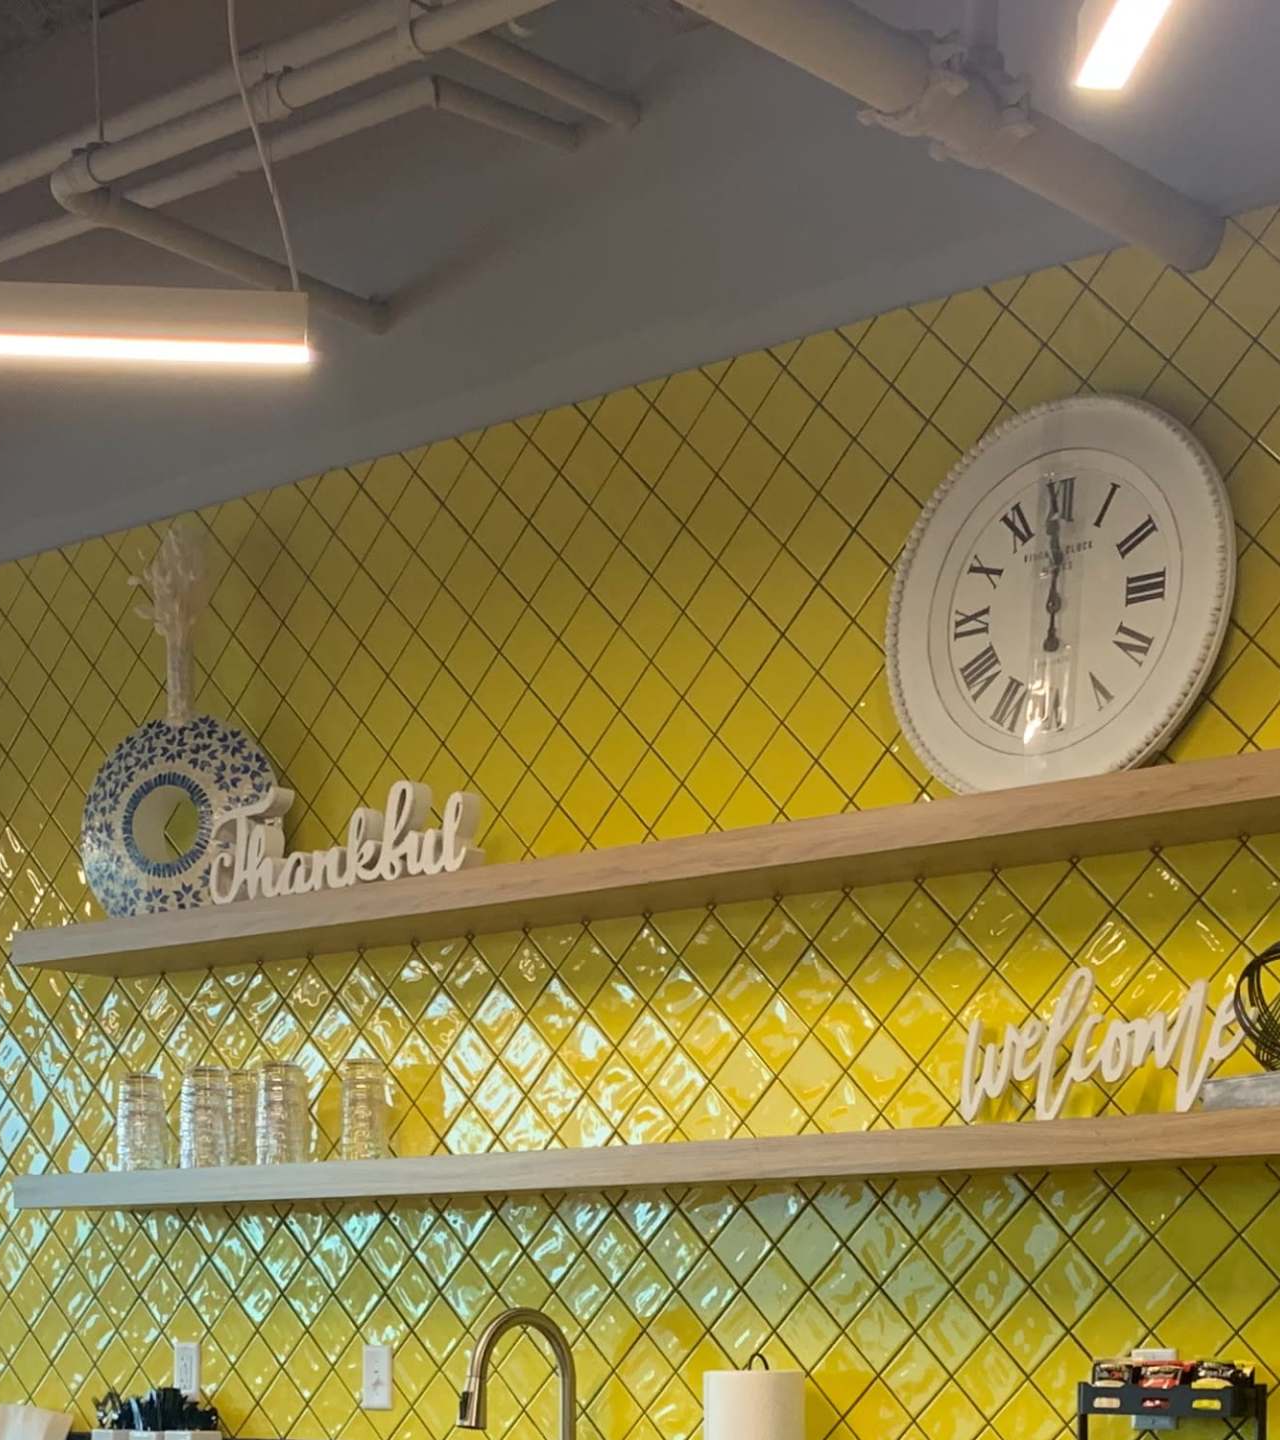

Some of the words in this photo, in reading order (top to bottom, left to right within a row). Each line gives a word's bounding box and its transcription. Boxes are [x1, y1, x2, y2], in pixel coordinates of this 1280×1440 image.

[1000, 502, 1036, 554] XI
[1116, 514, 1158, 559] II
[967, 554, 1005, 590] X
[1125, 567, 1166, 607] III
[954, 605, 991, 642] IX
[1112, 621, 1155, 667] IV
[960, 642, 1002, 703] VIII
[1088, 671, 1115, 712] V
[990, 675, 1028, 733] VII
[210, 780, 468, 905] Thankful
